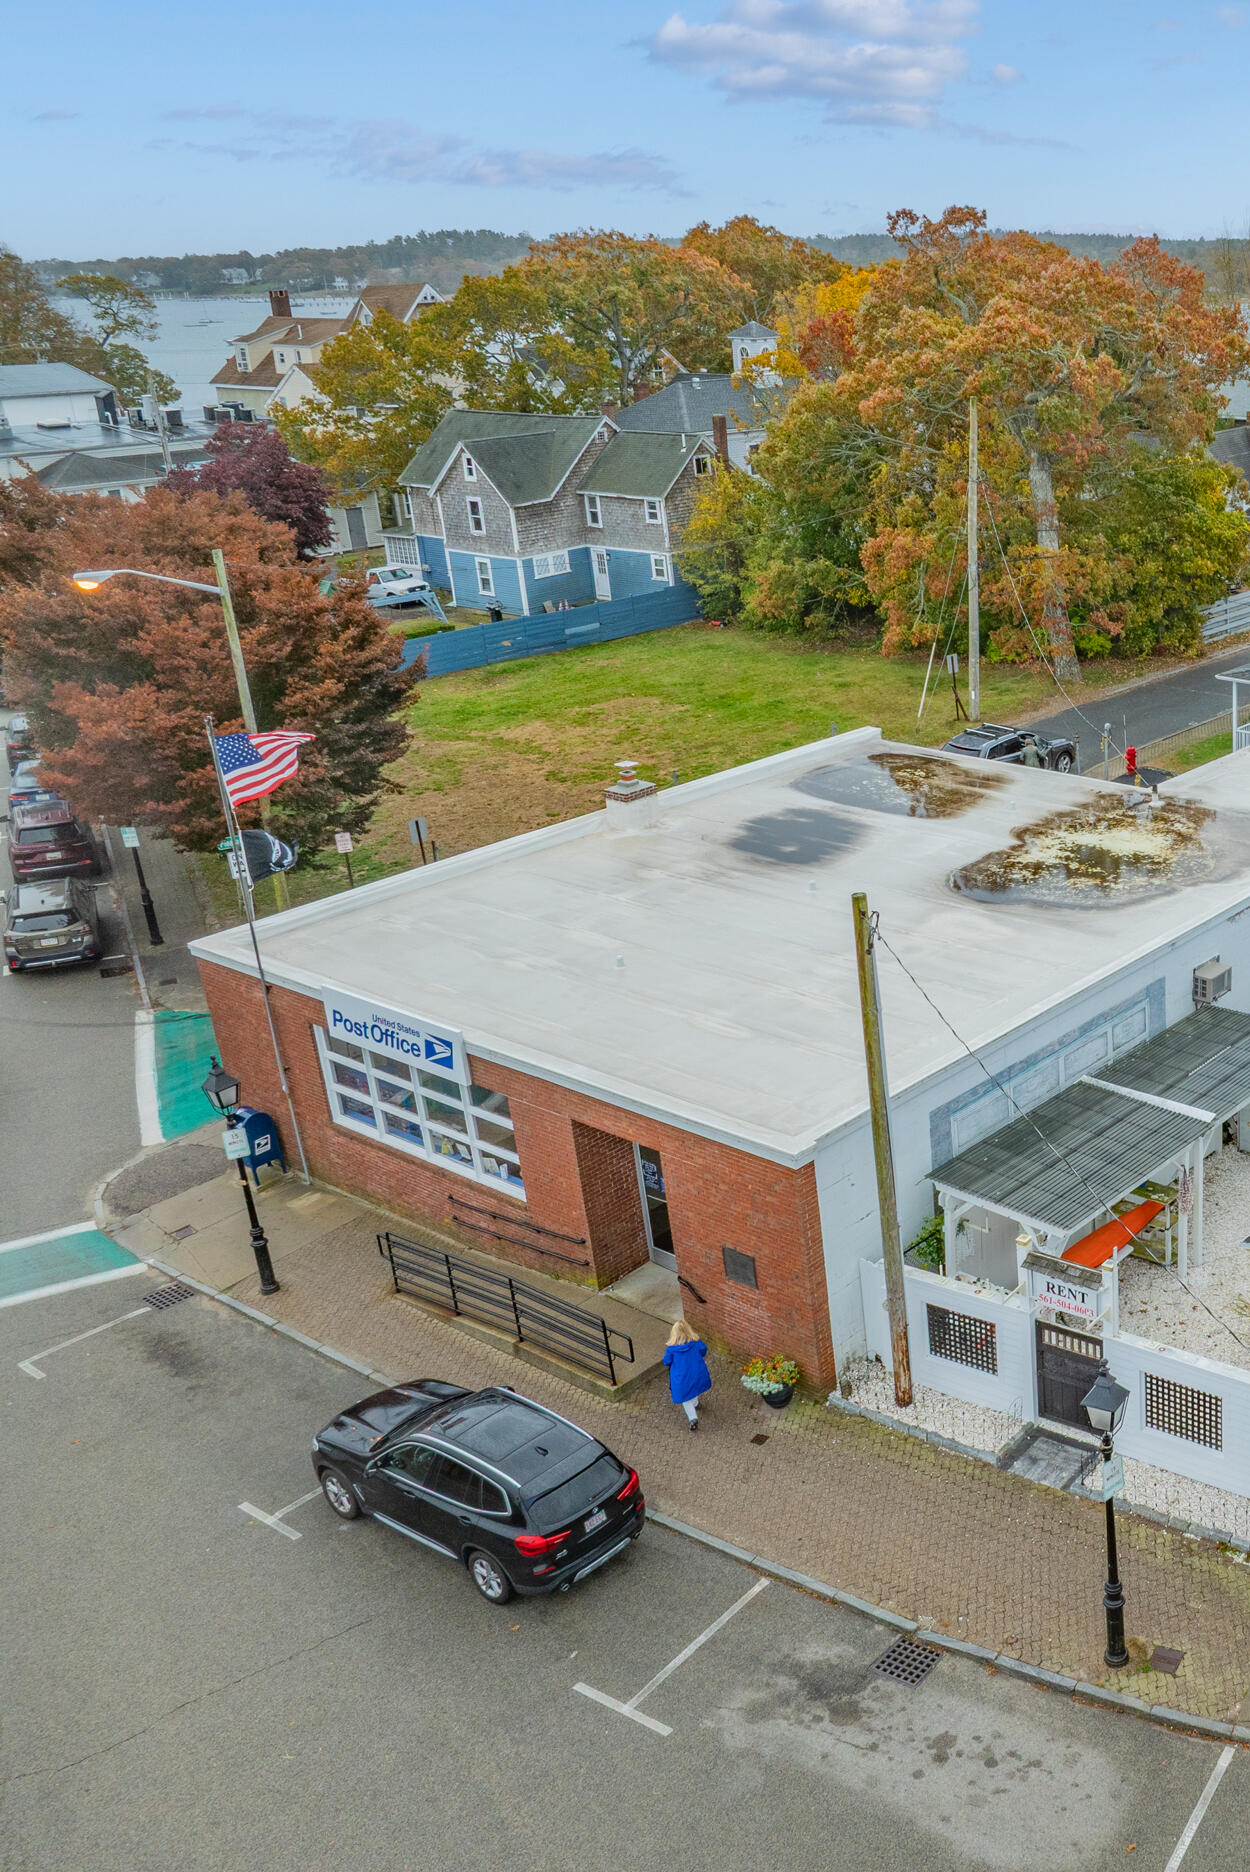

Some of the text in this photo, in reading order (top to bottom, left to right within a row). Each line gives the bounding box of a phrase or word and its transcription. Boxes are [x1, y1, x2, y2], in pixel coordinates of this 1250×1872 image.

[332, 1009, 421, 1058] Post Office
[372, 1014, 421, 1038] United States
[1046, 1281, 1089, 1304] RENT
